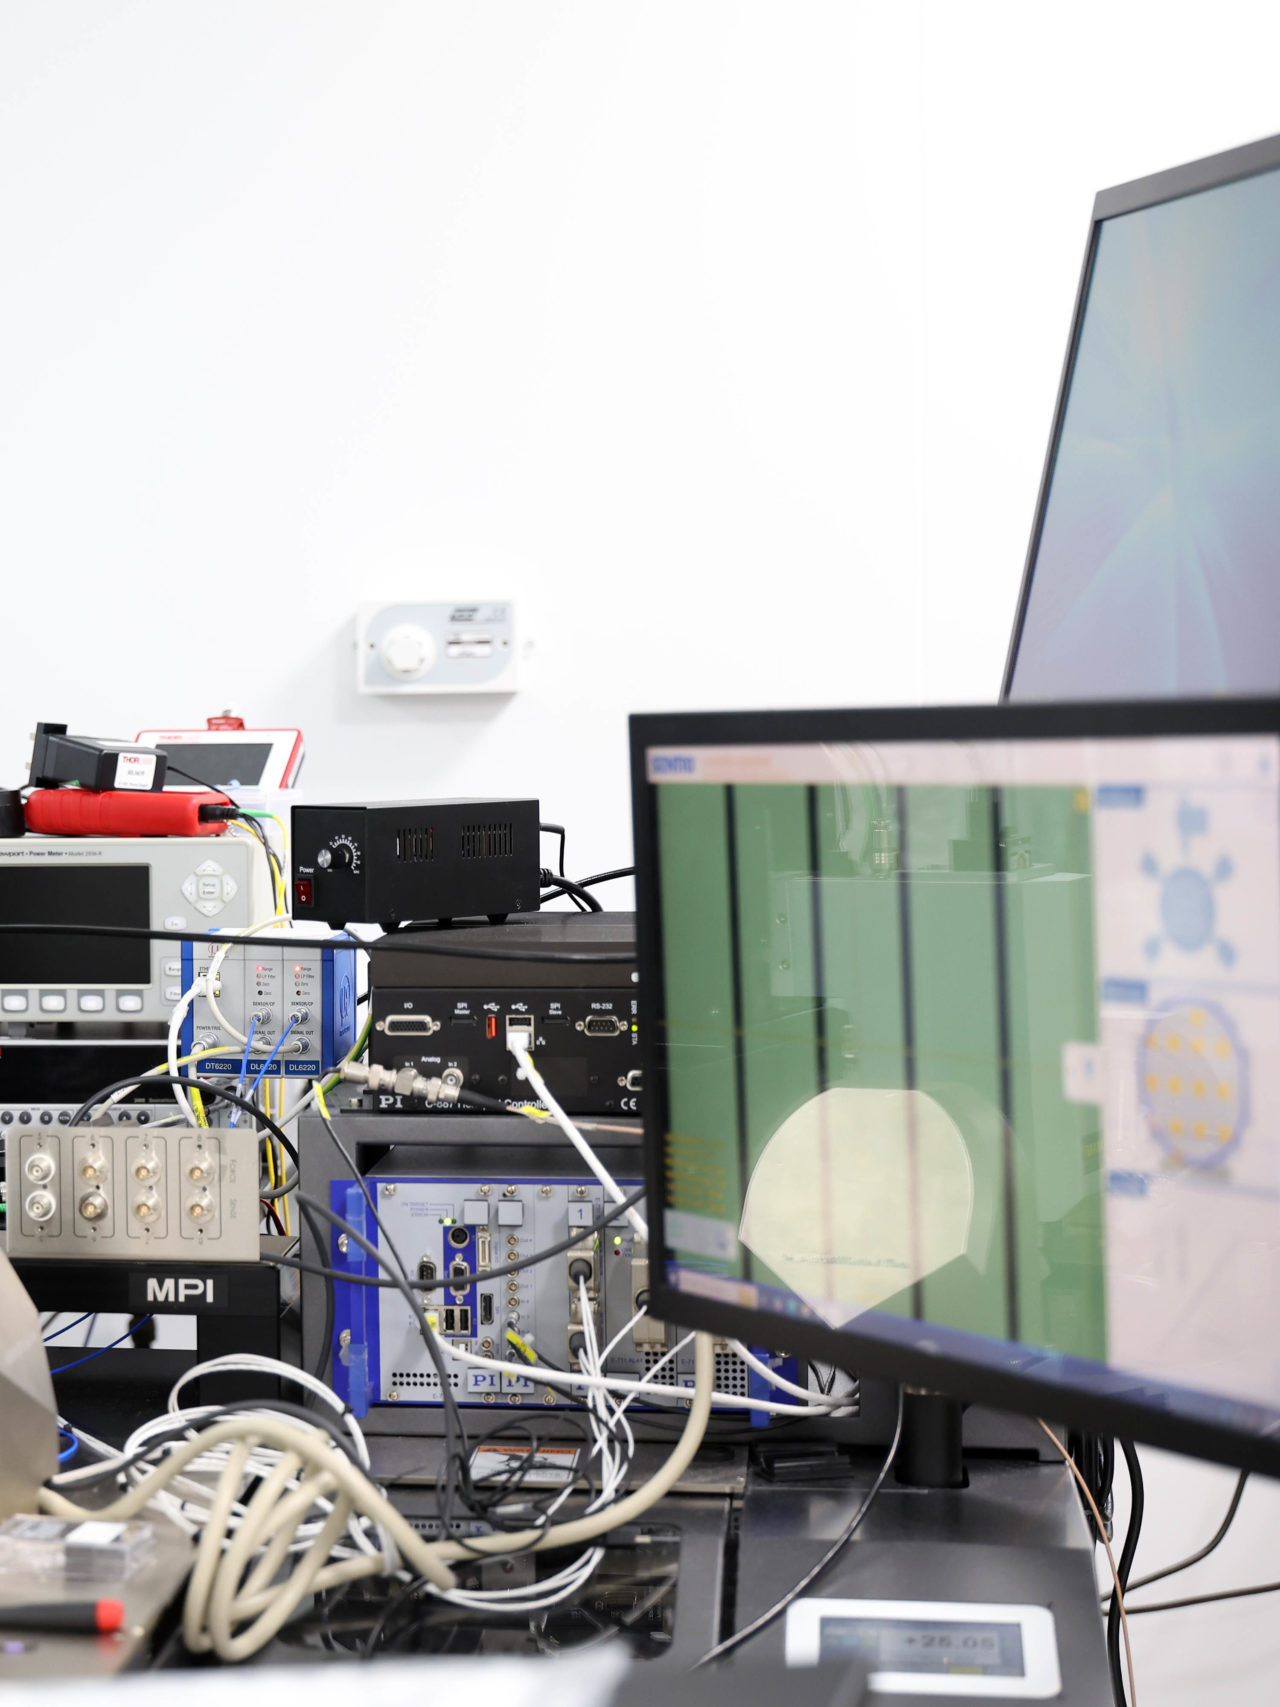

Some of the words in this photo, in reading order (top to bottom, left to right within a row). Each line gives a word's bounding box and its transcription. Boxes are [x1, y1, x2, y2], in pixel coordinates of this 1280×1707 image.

[299, 866, 315, 874] Power
[421, 1056, 441, 1064] Analog
[205, 1062, 232, 1070] DT6220
[250, 1063, 278, 1071] DL620
[379, 1095, 403, 1109] PI
[147, 1277, 214, 1303] MPI
[473, 1374, 496, 1387] PI
